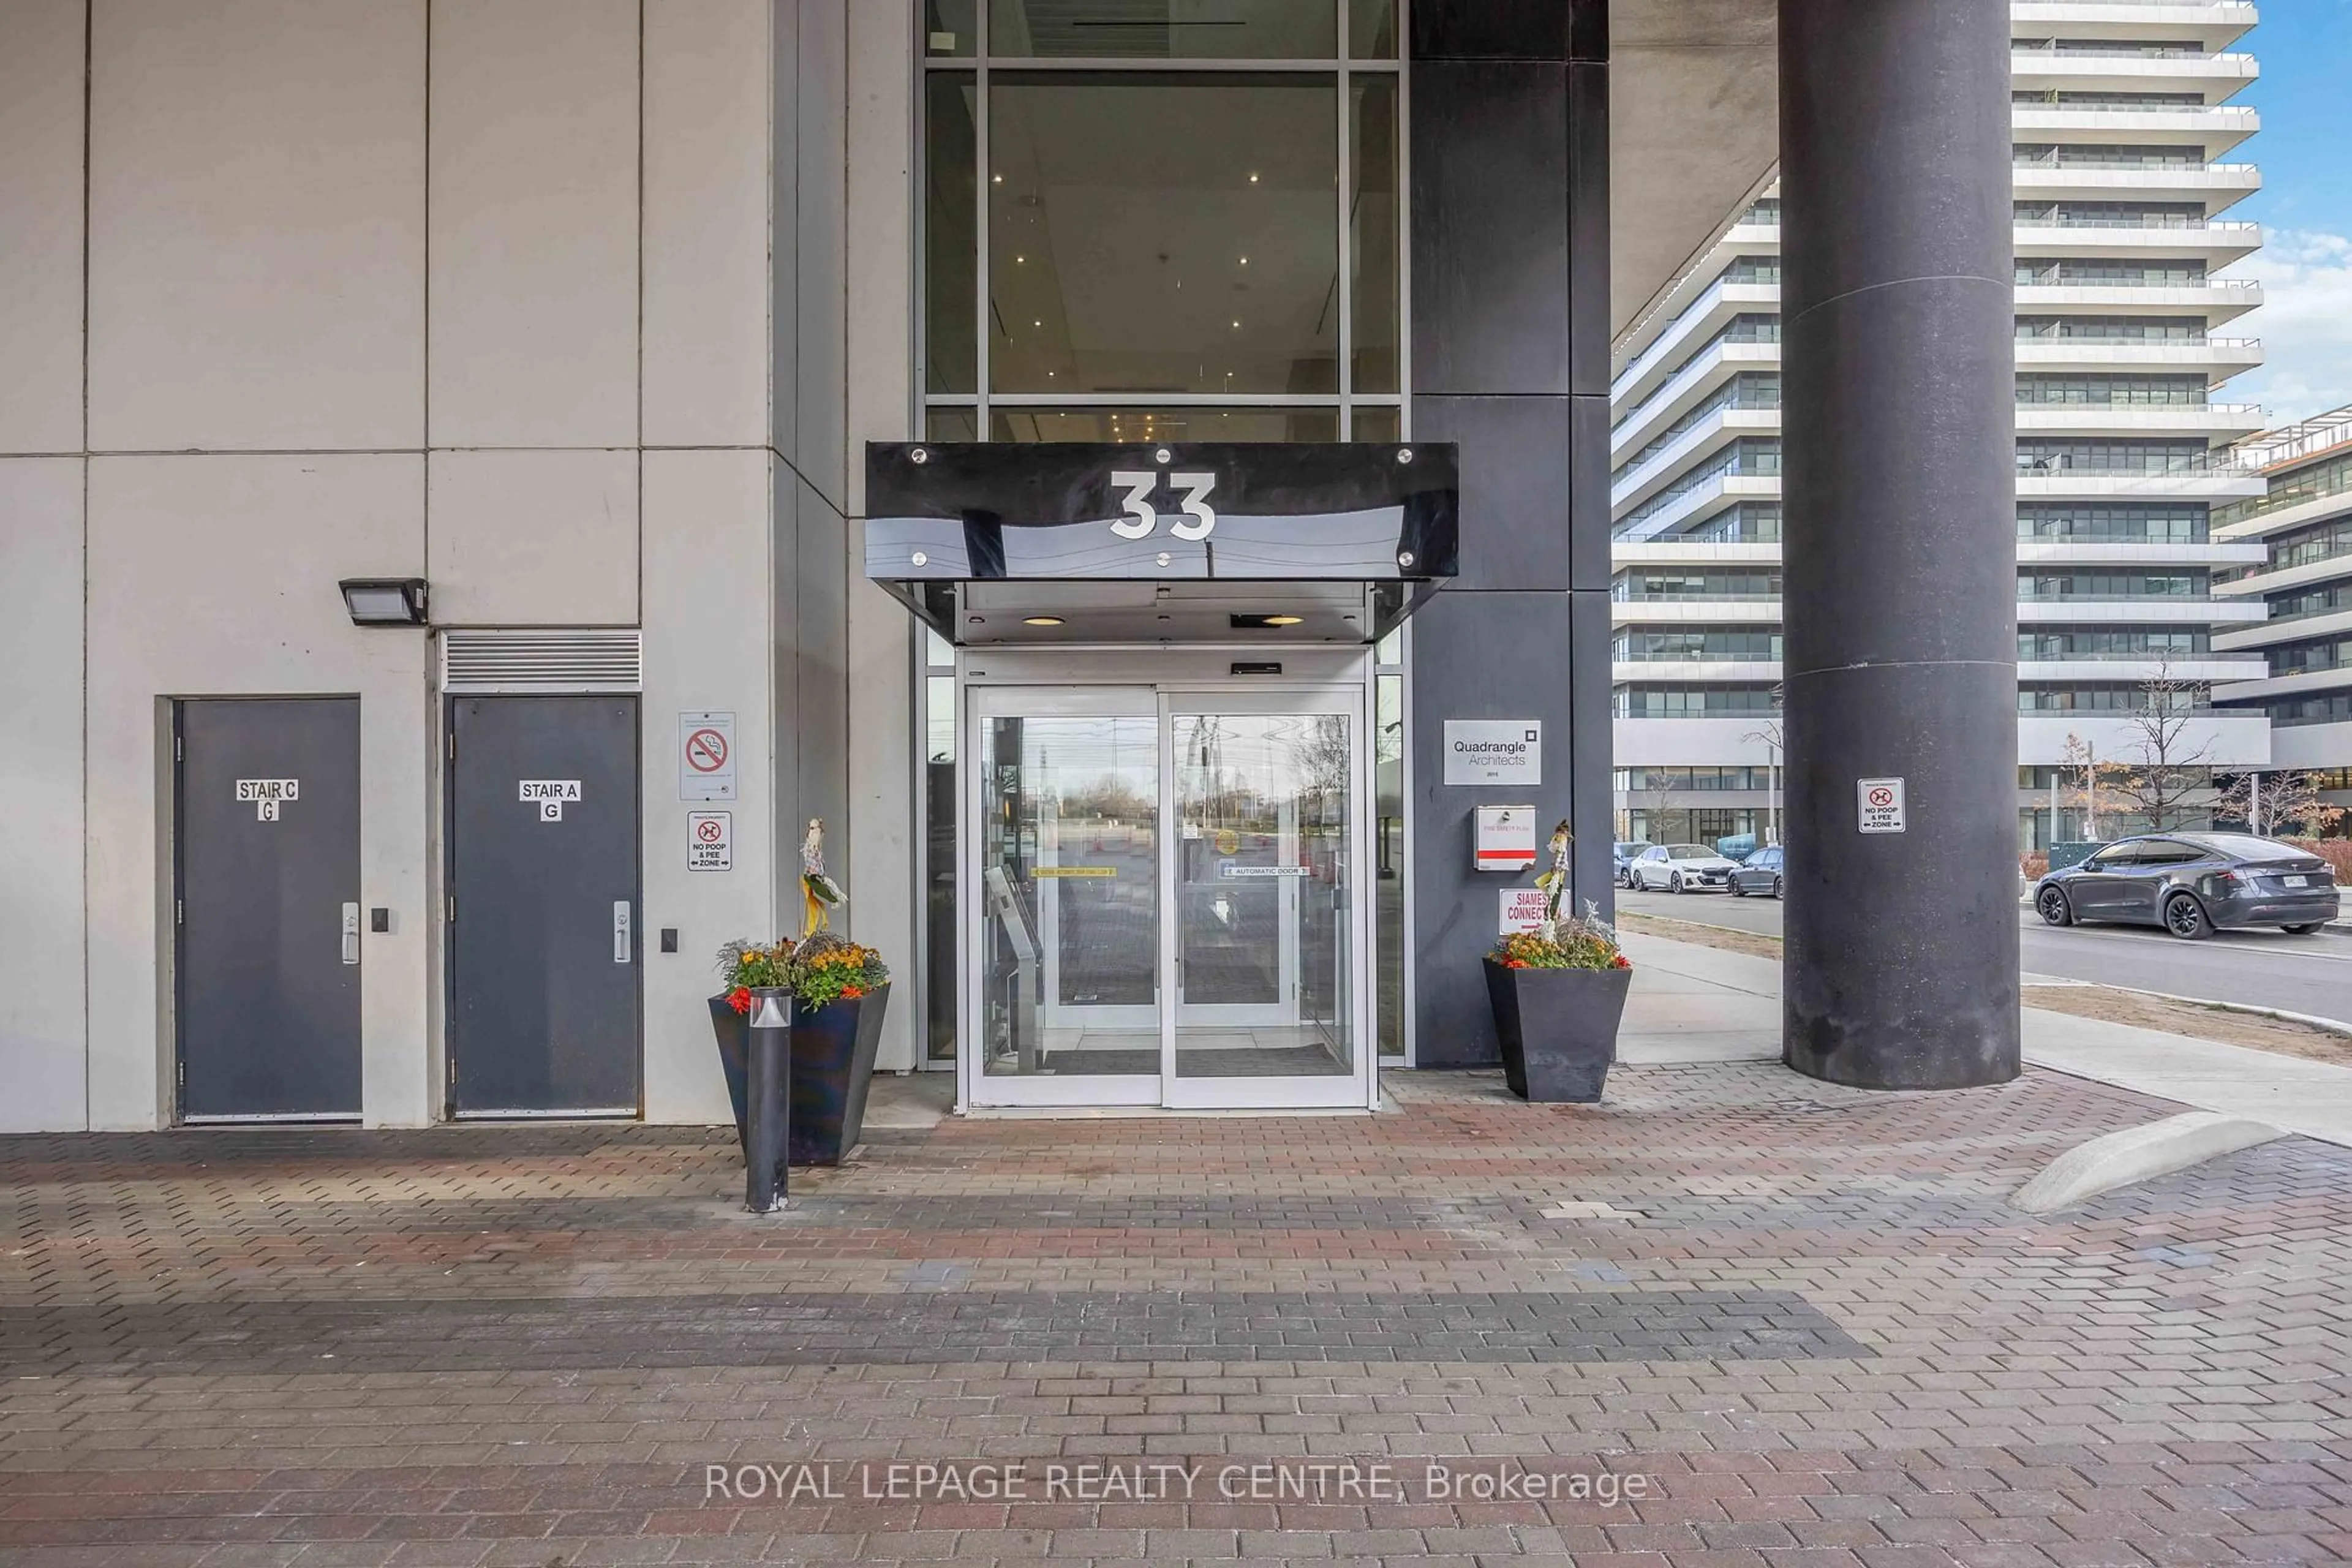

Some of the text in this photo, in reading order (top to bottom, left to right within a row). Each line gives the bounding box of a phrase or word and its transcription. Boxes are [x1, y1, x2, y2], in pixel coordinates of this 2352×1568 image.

[1110, 470, 1216, 541] 33
[1454, 741, 1526, 755] Quadrangle
[1469, 755, 1526, 766] Architects
[240, 782, 295, 798] STAIR C
[523, 783, 577, 797] STAIR A
[263, 802, 273, 820] G
[545, 804, 557, 818] G
[1517, 893, 1548, 906] SIAMES
